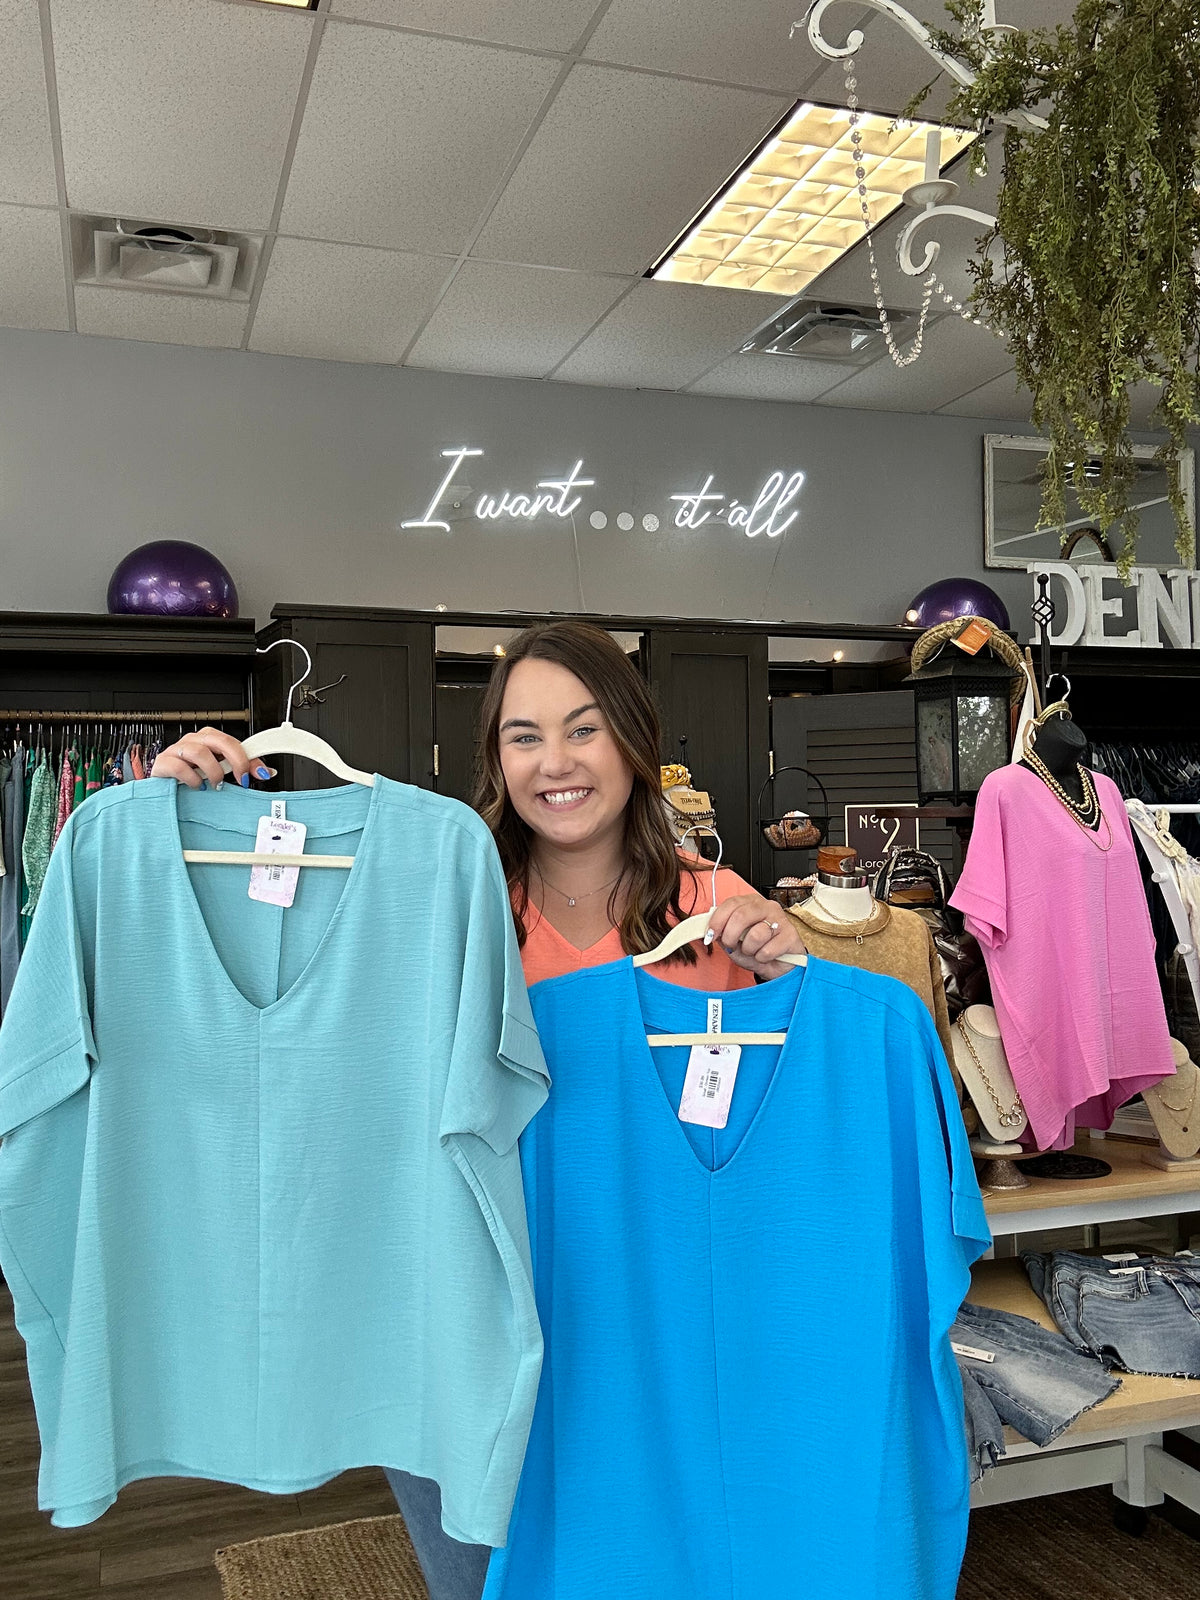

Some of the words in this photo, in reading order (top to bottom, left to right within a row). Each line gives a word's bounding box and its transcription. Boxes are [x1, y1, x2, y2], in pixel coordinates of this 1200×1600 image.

[401, 447, 483, 532] I
[476, 459, 594, 519] want
[670, 475, 723, 529] it
[728, 472, 805, 538] all
